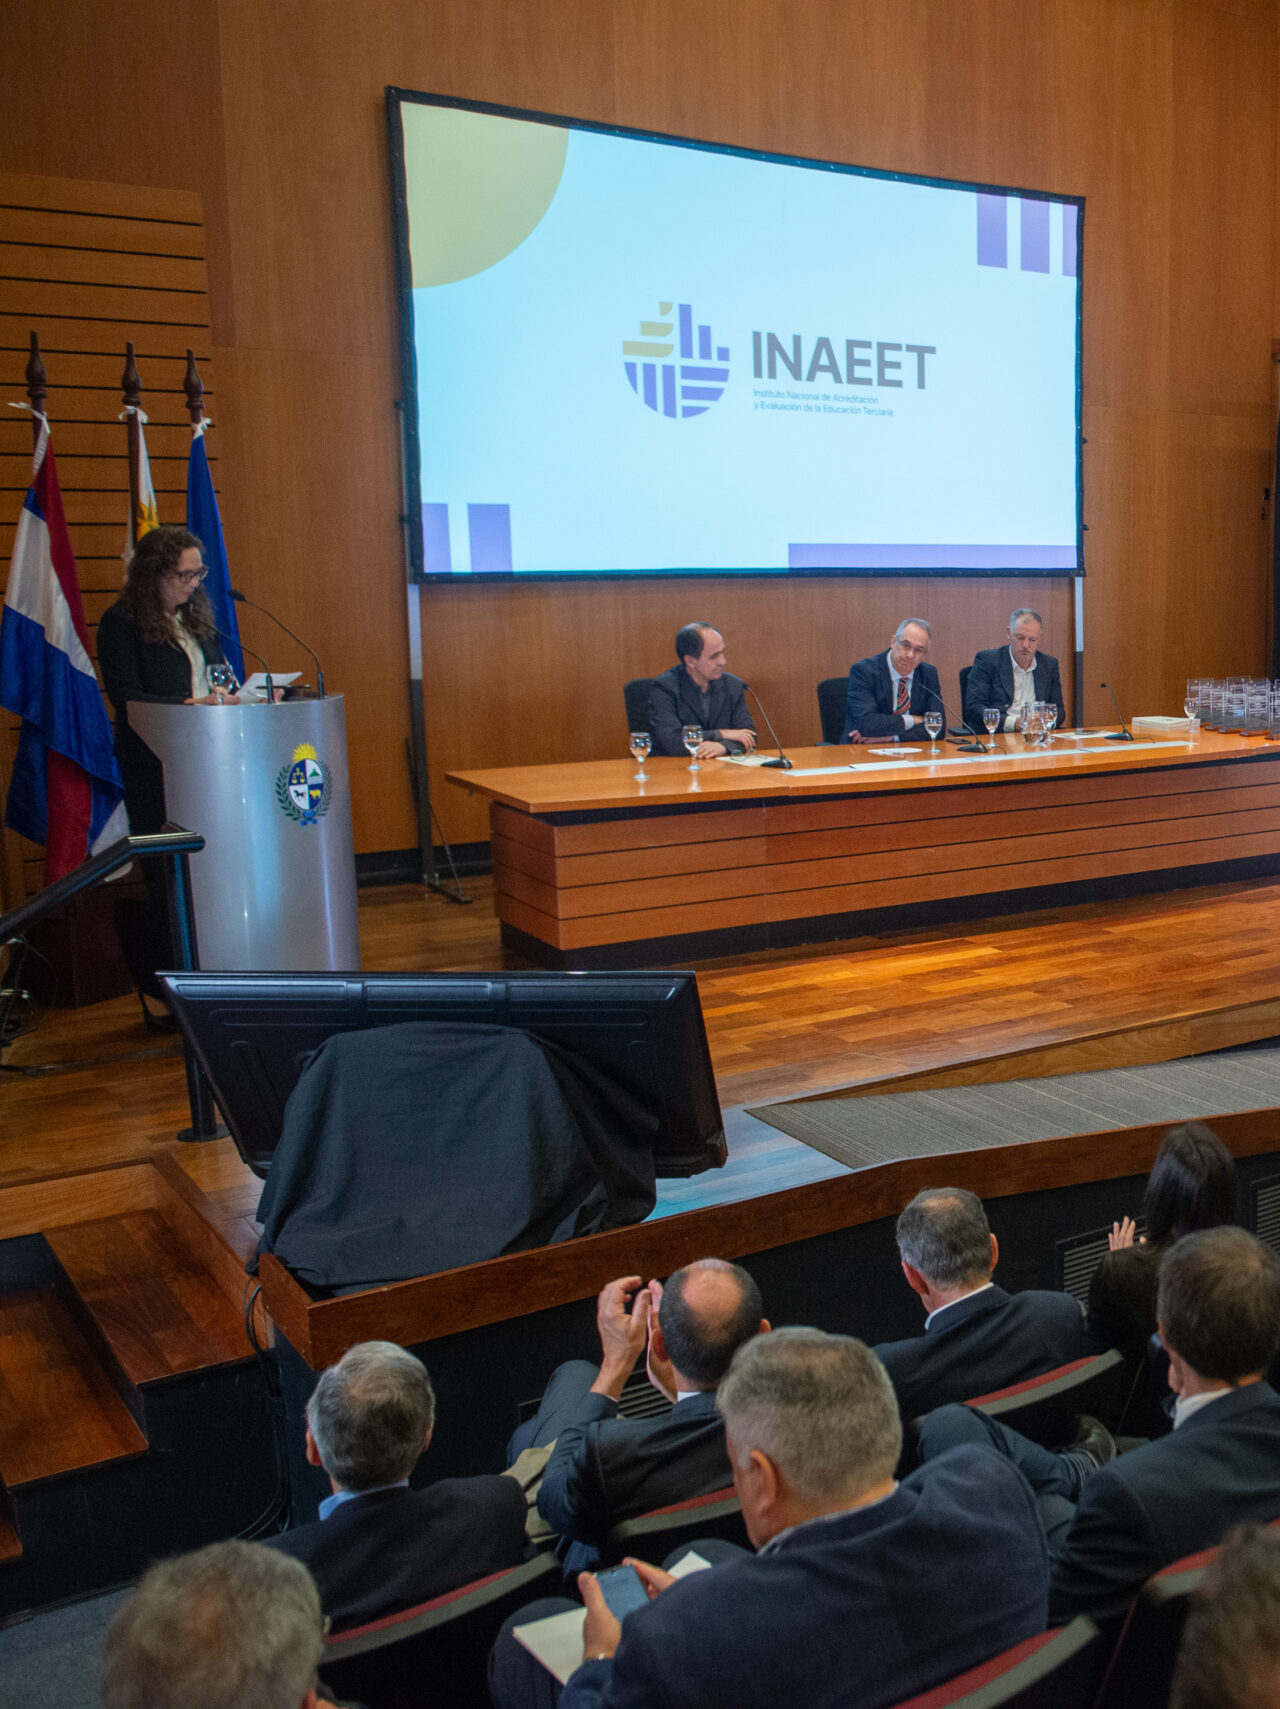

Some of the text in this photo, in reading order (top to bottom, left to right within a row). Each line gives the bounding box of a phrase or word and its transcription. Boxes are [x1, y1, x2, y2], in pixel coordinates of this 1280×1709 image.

[752, 331, 937, 390] INAEET
[753, 389, 879, 404] Instituto Nacional de Acreditación
[753, 401, 894, 417] y Evaluación de la Educación Terciaria
